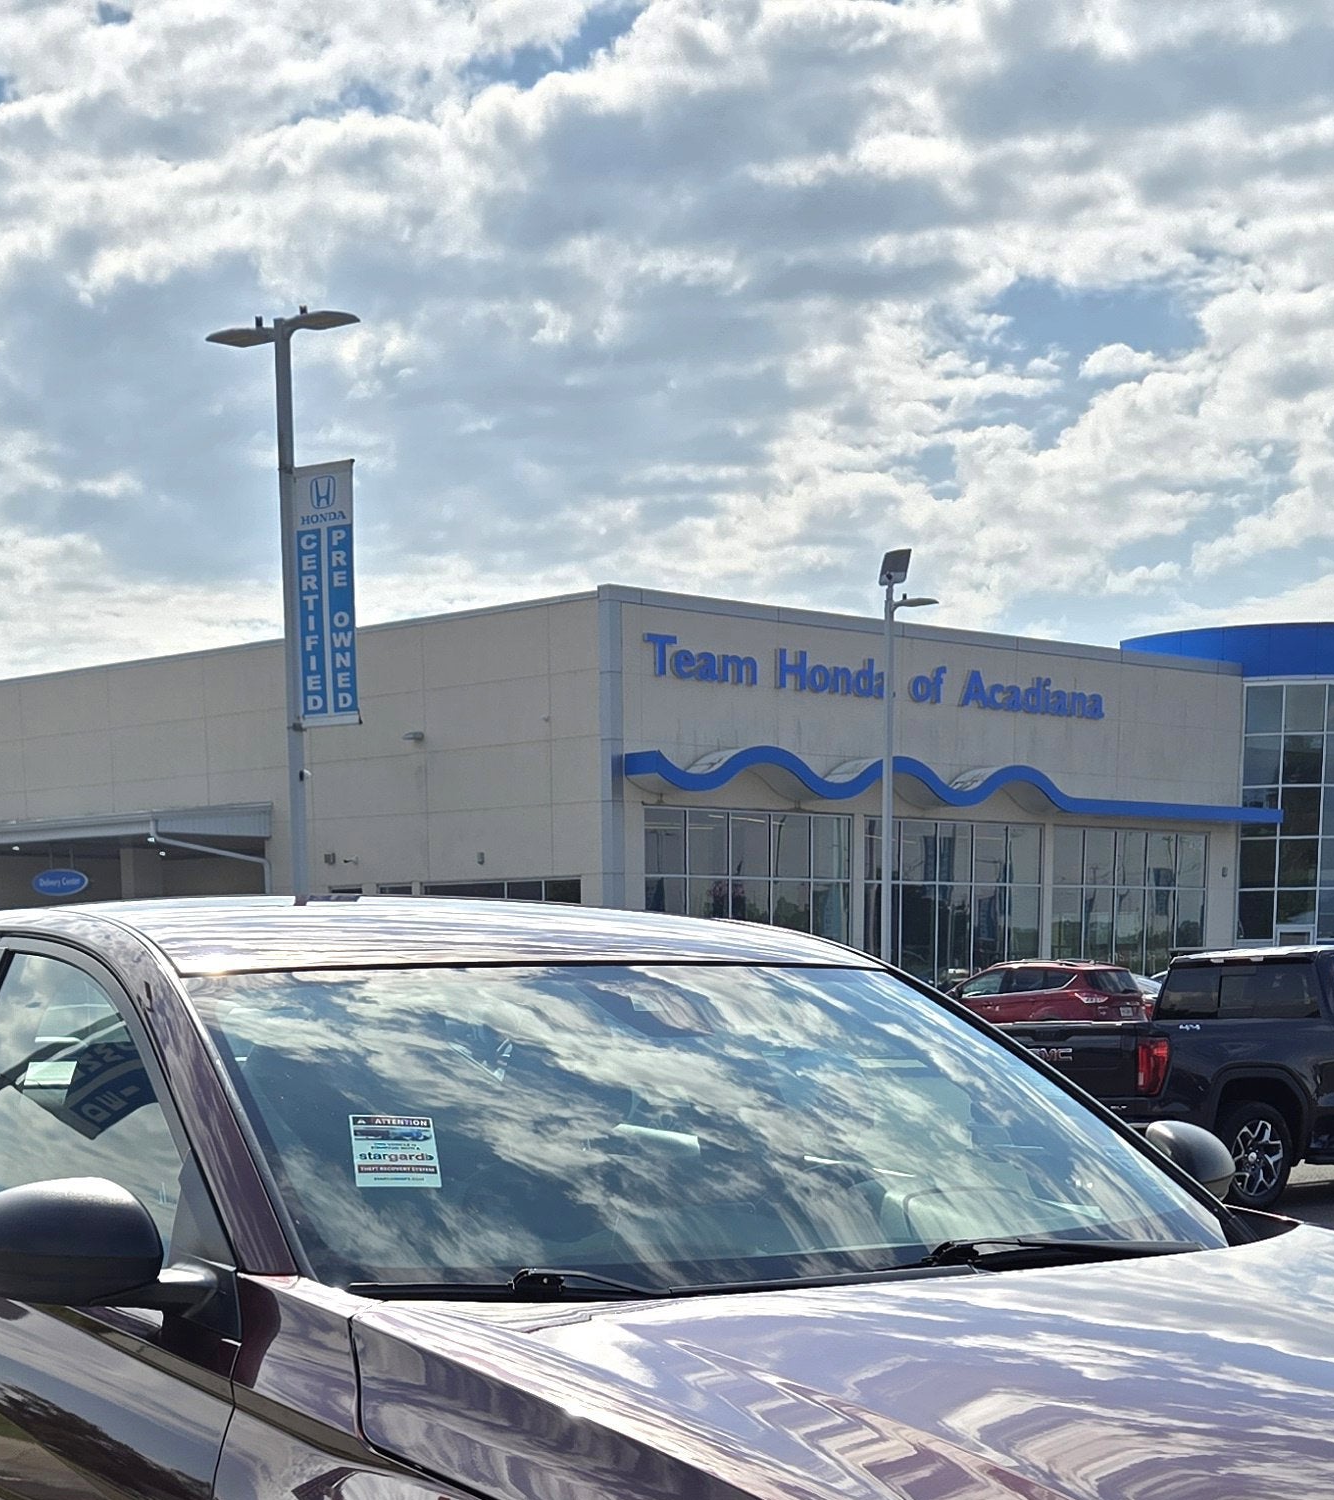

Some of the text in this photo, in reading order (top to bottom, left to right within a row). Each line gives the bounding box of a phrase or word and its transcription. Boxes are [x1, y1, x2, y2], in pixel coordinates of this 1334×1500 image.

[300, 510, 347, 526] HONDA
[300, 533, 323, 712] CERTIFIED
[331, 529, 352, 709] PRE OWNED
[642, 632, 758, 686] Team
[908, 666, 947, 705] of
[958, 669, 1105, 720] Acadiana
[374, 1118, 428, 1127] ATTENTION
